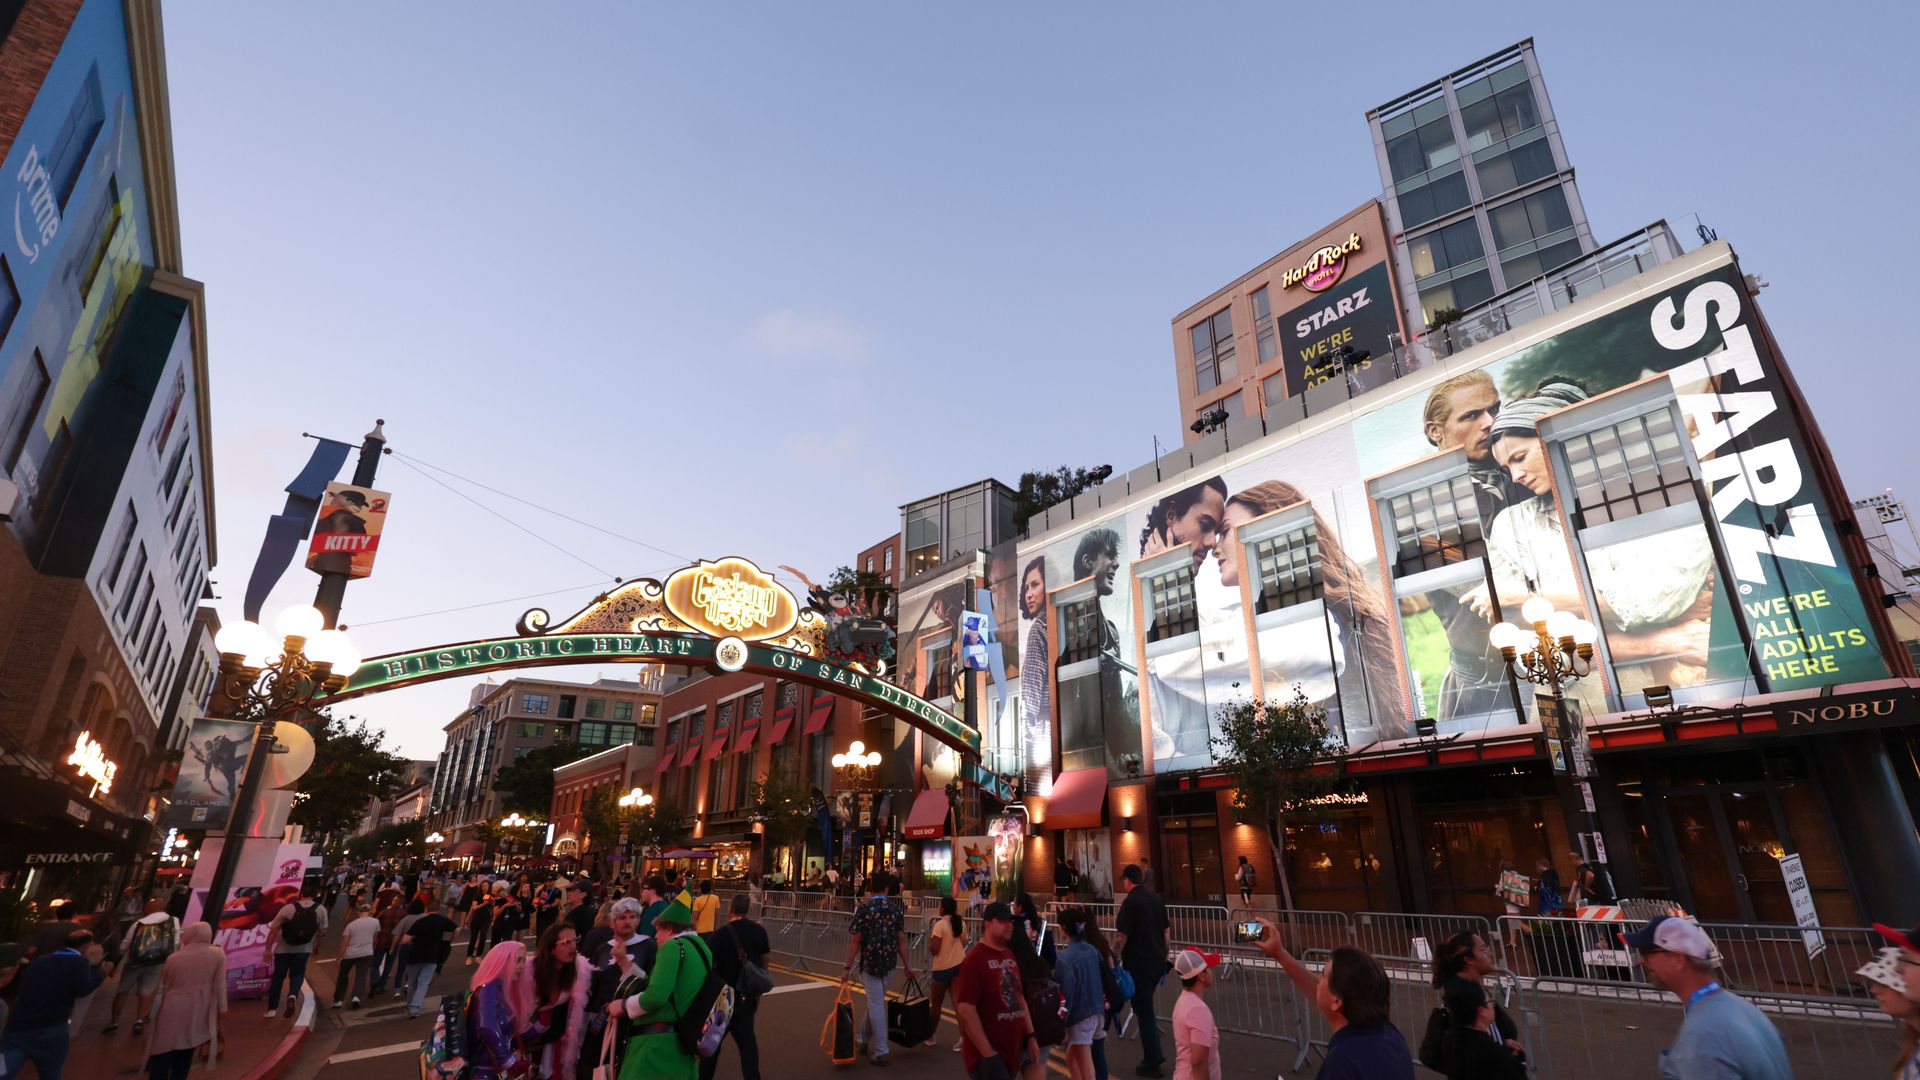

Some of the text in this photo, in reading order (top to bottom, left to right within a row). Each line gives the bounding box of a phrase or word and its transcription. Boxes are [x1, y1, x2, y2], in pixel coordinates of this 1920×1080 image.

[17, 143, 58, 247] prime
[1281, 232, 1361, 289] Hard Rock
[1311, 268, 1335, 284] HOTEL
[1296, 287, 1370, 338] STARZ
[1300, 328, 1353, 362] WE'RE
[1650, 280, 1837, 586] STARZ
[324, 535, 372, 551] KITTY
[1744, 589, 1831, 619] WE'RE
[1755, 617, 1803, 640] ALL
[1762, 628, 1867, 661] ADULTS
[384, 636, 946, 727] HISTORIC HEART OF SAN DIEGO
[1767, 655, 1840, 681] HERE
[1788, 699, 1897, 725] NOBU
[25, 852, 114, 864] ENTRANCE
